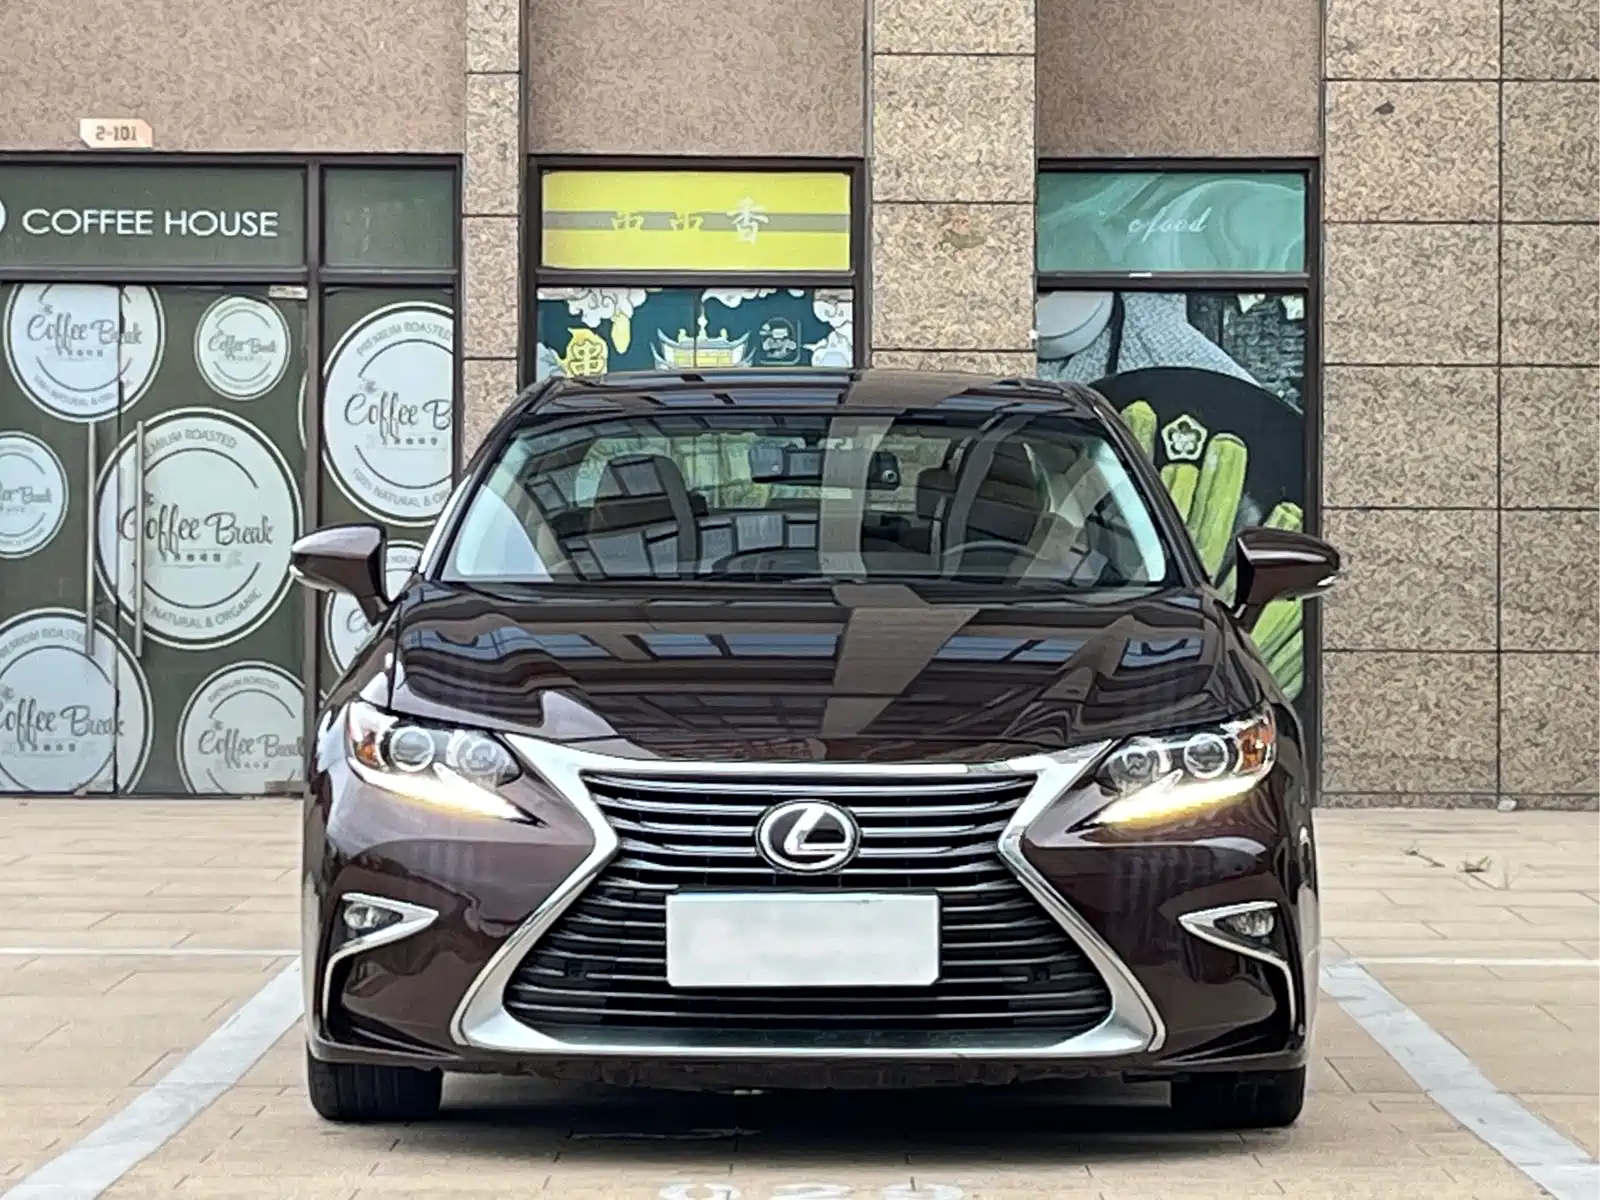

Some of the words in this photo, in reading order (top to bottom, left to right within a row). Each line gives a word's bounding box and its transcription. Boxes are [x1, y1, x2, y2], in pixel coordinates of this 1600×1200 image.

[94, 125, 137, 142] 2-101
[22, 208, 154, 236] COFFEE
[164, 210, 279, 237] HOUSE
[344, 391, 419, 442] Coffee
[184, 428, 238, 449] ROASTED
[120, 502, 201, 559] Coffee
[203, 511, 275, 547] Break
[215, 587, 263, 626] ORGANIC
